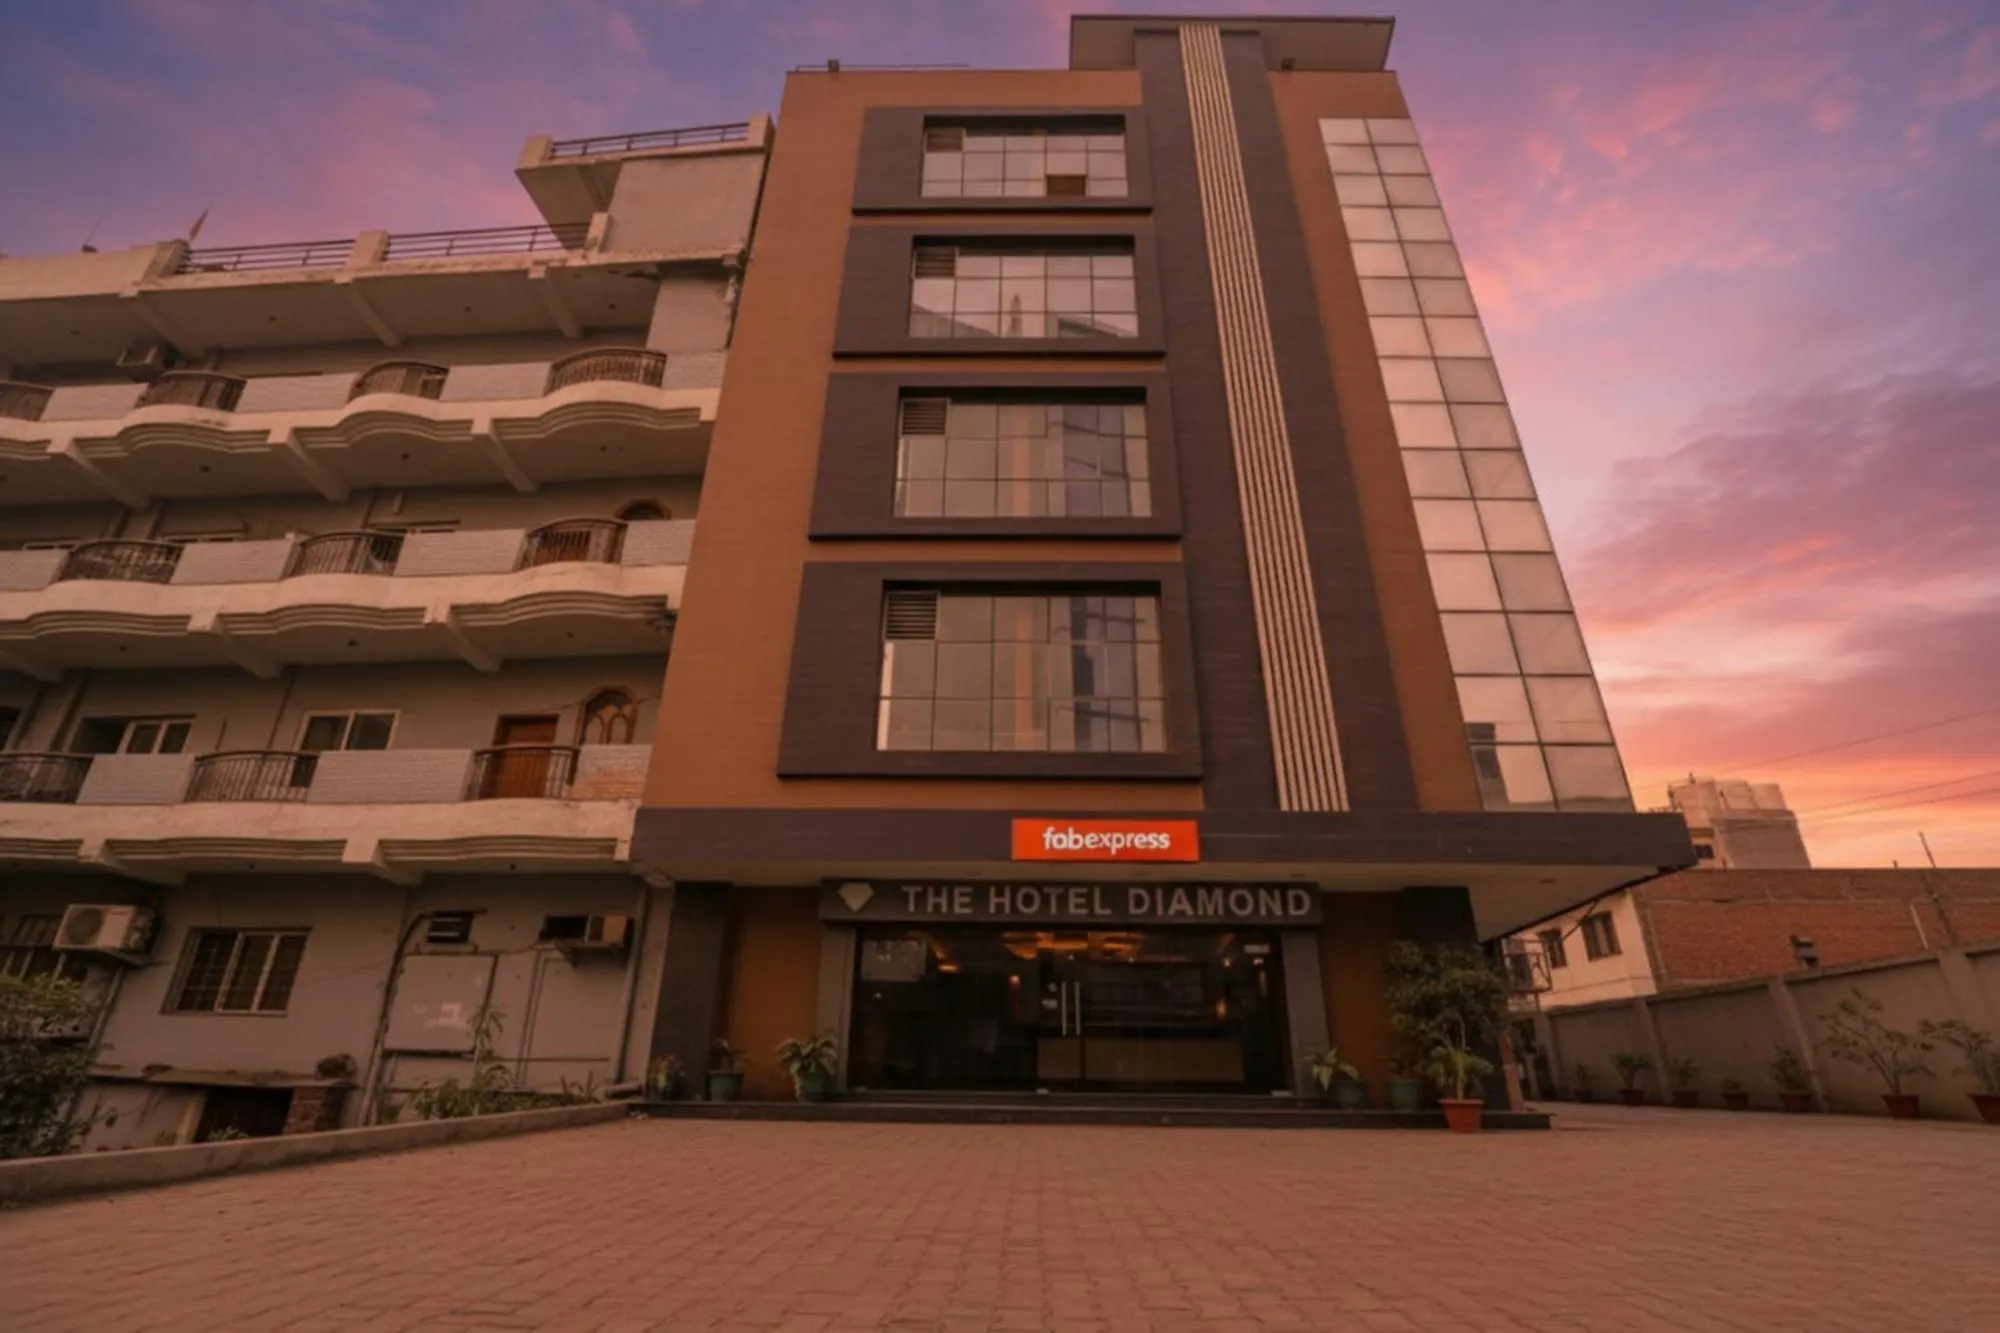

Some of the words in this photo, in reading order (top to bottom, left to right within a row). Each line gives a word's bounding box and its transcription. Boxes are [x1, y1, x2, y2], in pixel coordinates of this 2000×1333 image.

[1043, 826, 1171, 854] fabexpress
[902, 886, 972, 914] THE
[988, 887, 1112, 916] HOTEL
[1128, 888, 1312, 918] DIAMOND
